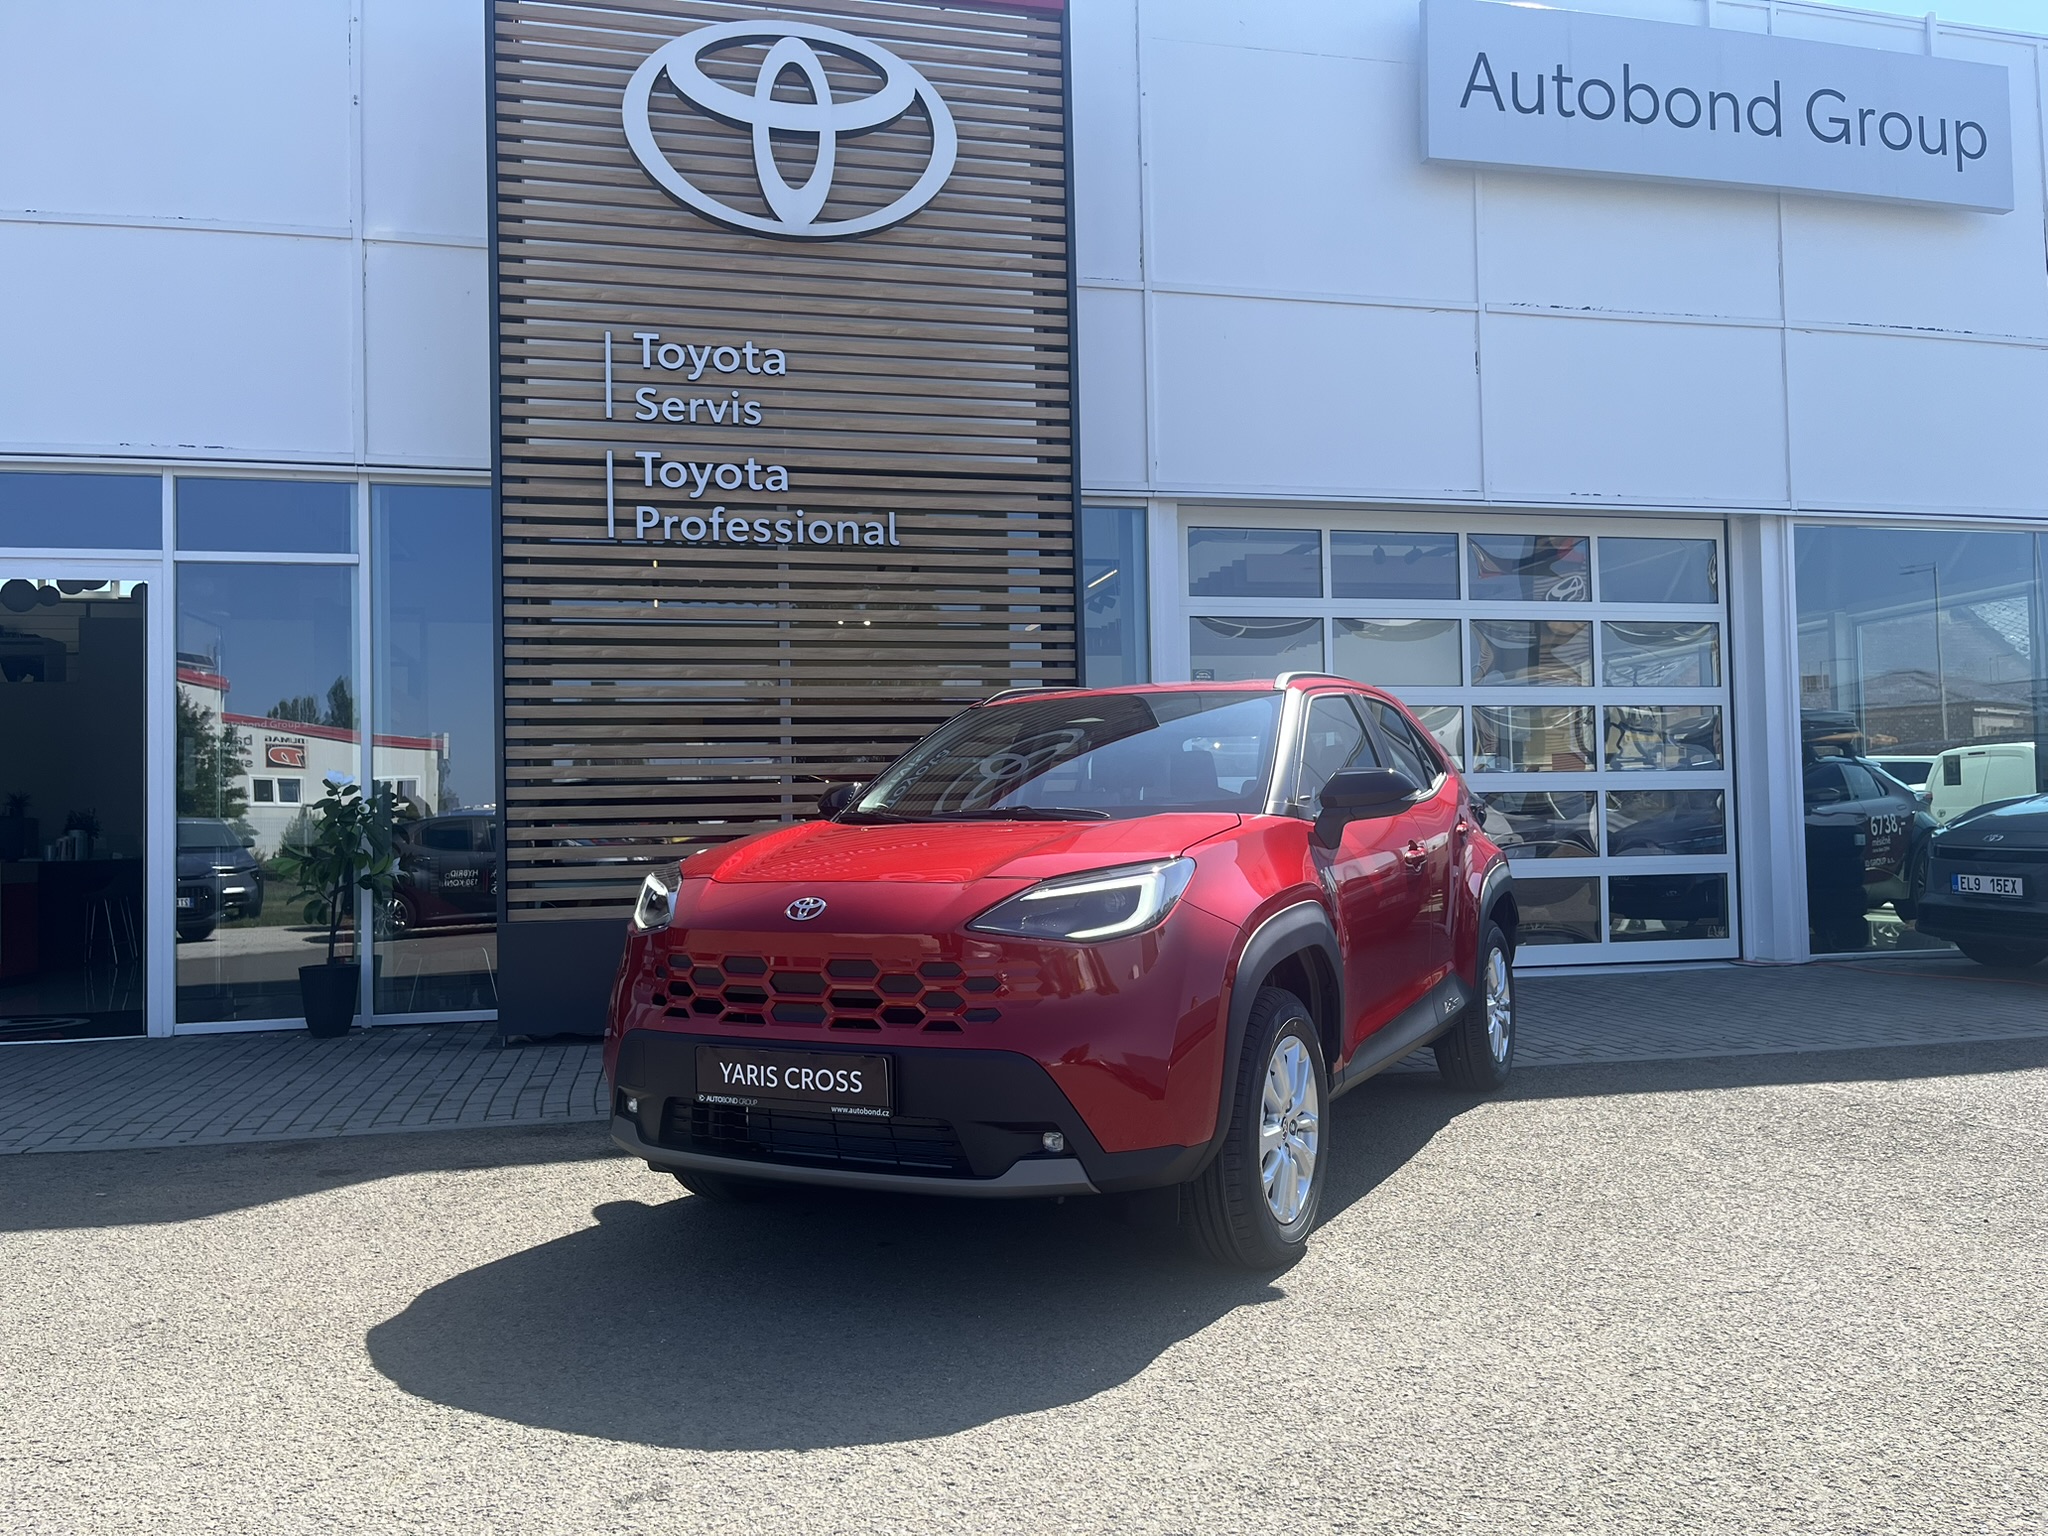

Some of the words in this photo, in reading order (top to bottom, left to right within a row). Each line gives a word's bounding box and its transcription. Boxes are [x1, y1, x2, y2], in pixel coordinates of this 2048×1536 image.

[1459, 51, 1782, 138] Autobond
[1805, 88, 1988, 173] Group
[633, 332, 786, 381] Toyota
[635, 387, 762, 426] Servis
[635, 451, 789, 499] Toyota
[636, 506, 900, 546] Professional
[1960, 876, 1981, 891] EL9
[1990, 878, 2017, 894] 15EX
[719, 1061, 778, 1089] YARIS
[784, 1067, 862, 1094] CROSS
[706, 1095, 738, 1104] AUTOBOND
[831, 1106, 890, 1117] www.autobond.cz
